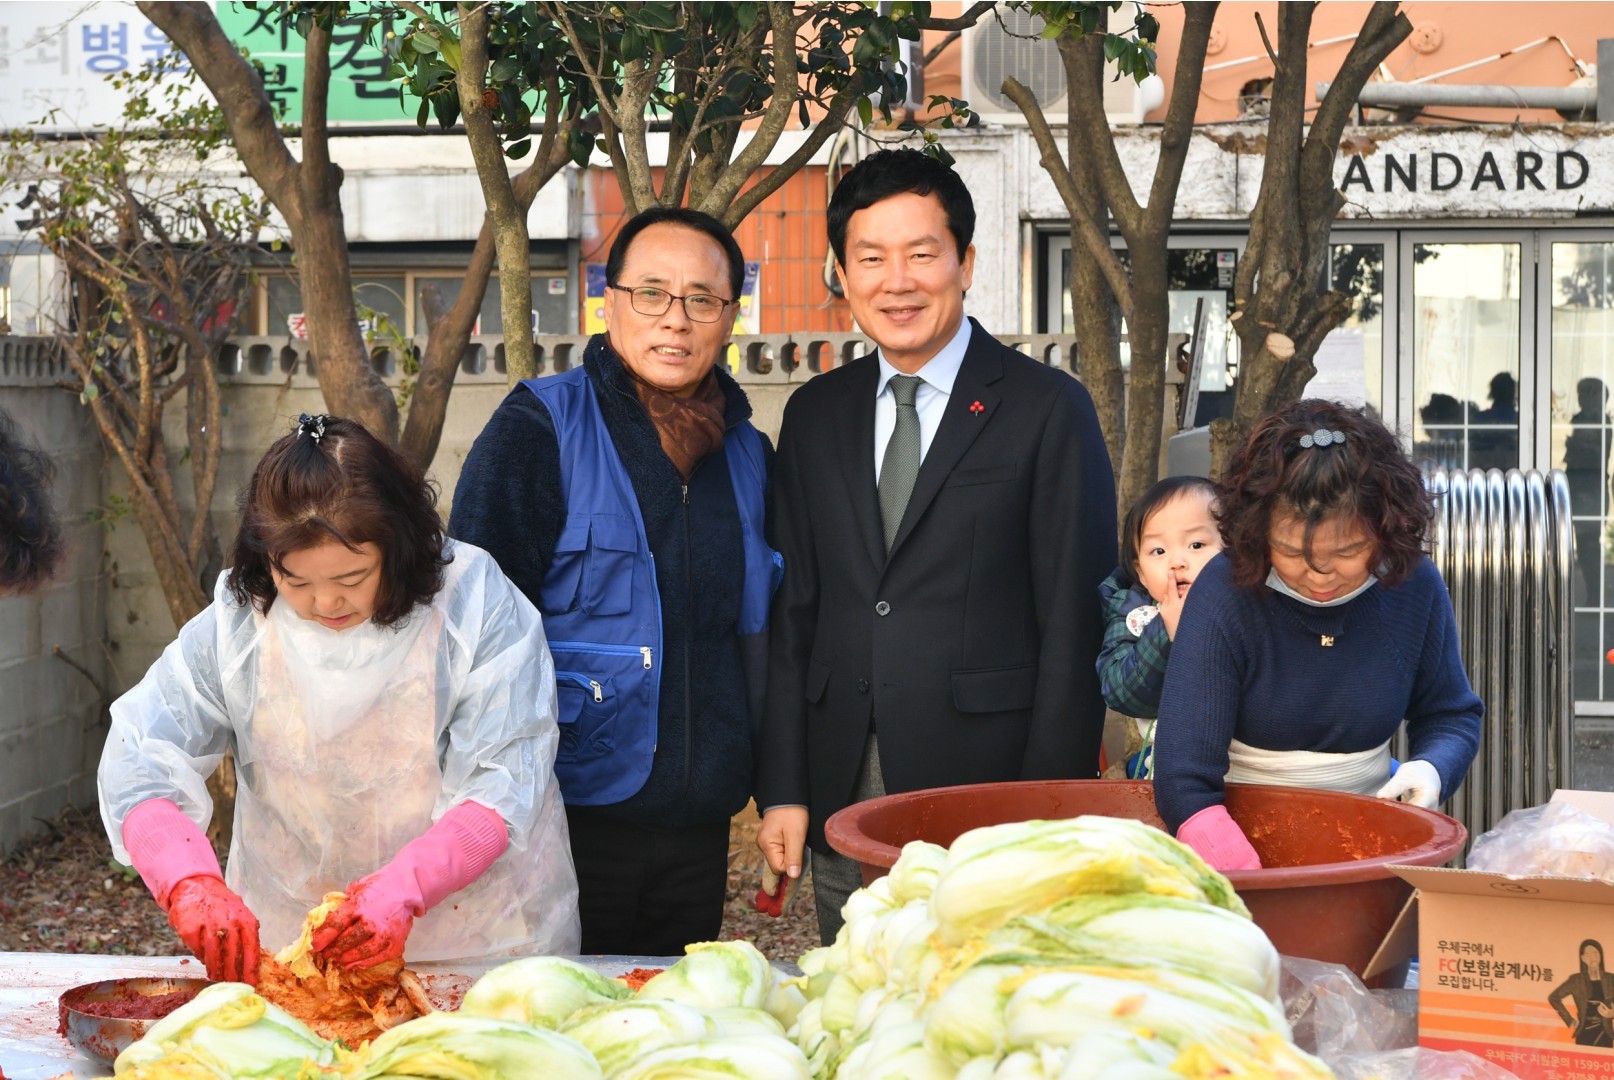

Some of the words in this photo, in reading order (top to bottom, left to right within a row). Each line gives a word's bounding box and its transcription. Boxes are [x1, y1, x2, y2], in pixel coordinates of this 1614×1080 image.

[1437, 940, 1494, 957] 우체국에서
[1439, 958, 1553, 982] FC(보험설계사)를
[1438, 975, 1498, 992] 모집합니다.
